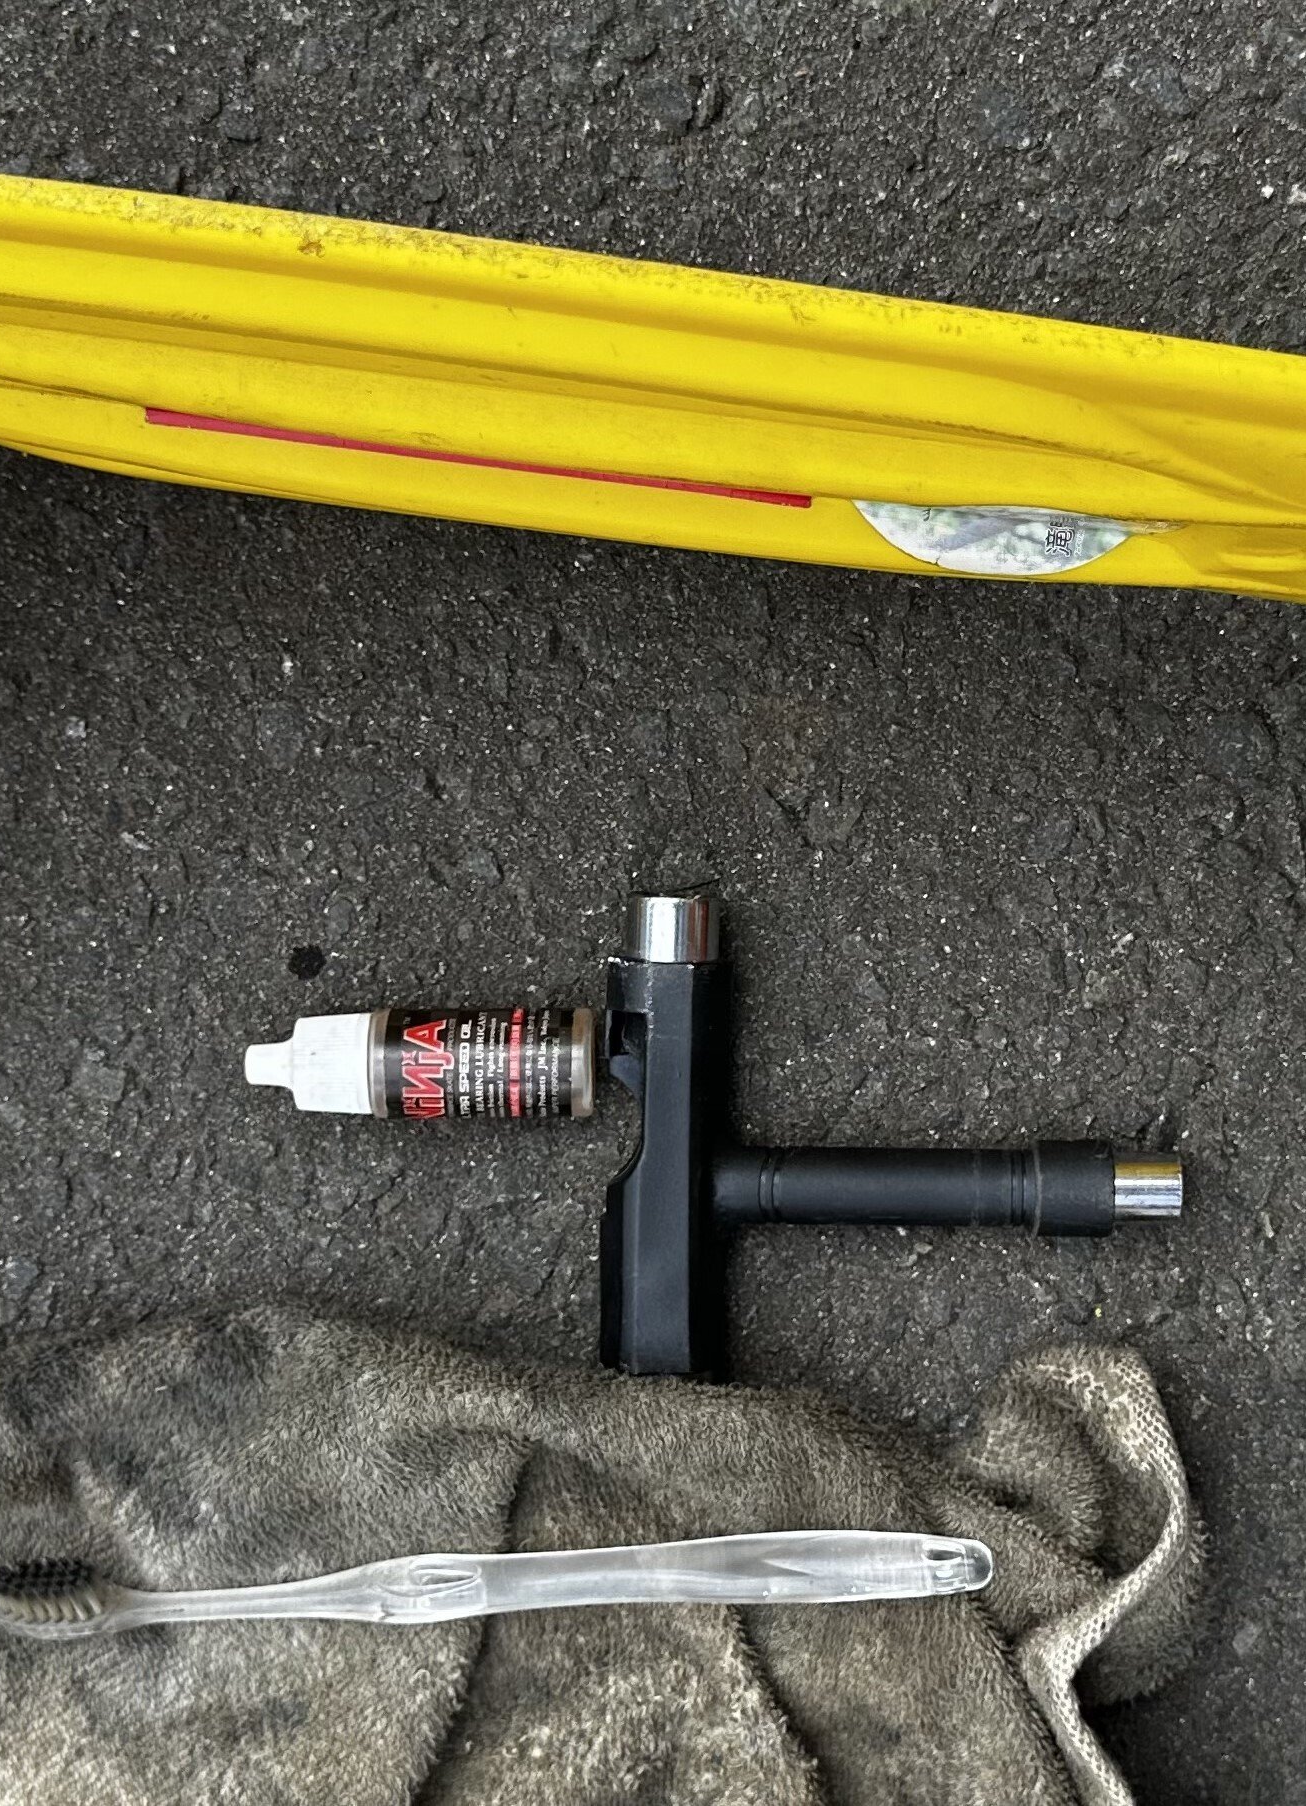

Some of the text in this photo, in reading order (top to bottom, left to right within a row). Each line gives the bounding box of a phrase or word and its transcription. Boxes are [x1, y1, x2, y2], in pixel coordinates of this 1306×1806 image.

[460, 1019, 472, 1039] OIL
[475, 1011, 487, 1066] LUBRICANT
[459, 1042, 470, 1092] SPEED
[475, 1069, 485, 1112] BEARING
